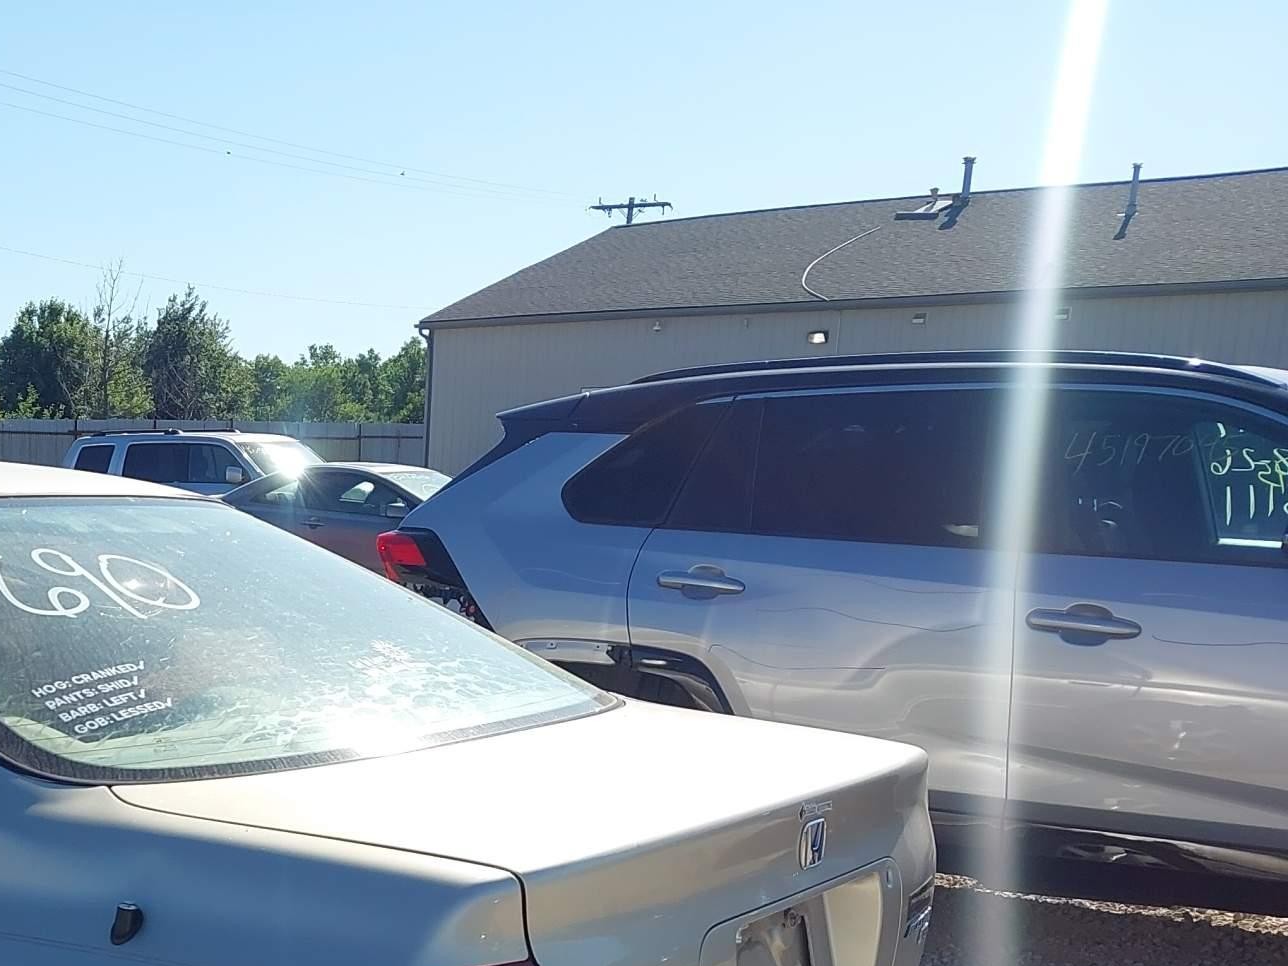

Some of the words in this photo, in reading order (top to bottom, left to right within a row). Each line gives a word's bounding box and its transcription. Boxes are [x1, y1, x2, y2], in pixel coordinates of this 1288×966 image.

[31, 680, 72, 698] HOG:
[72, 663, 137, 685] CRANKED
[45, 687, 98, 710] PANTS:
[97, 679, 132, 693] SHID
[58, 702, 103, 722] BARB:
[102, 691, 138, 707] LEFT
[74, 716, 114, 734] GOB:
[111, 700, 165, 721] LESSED
